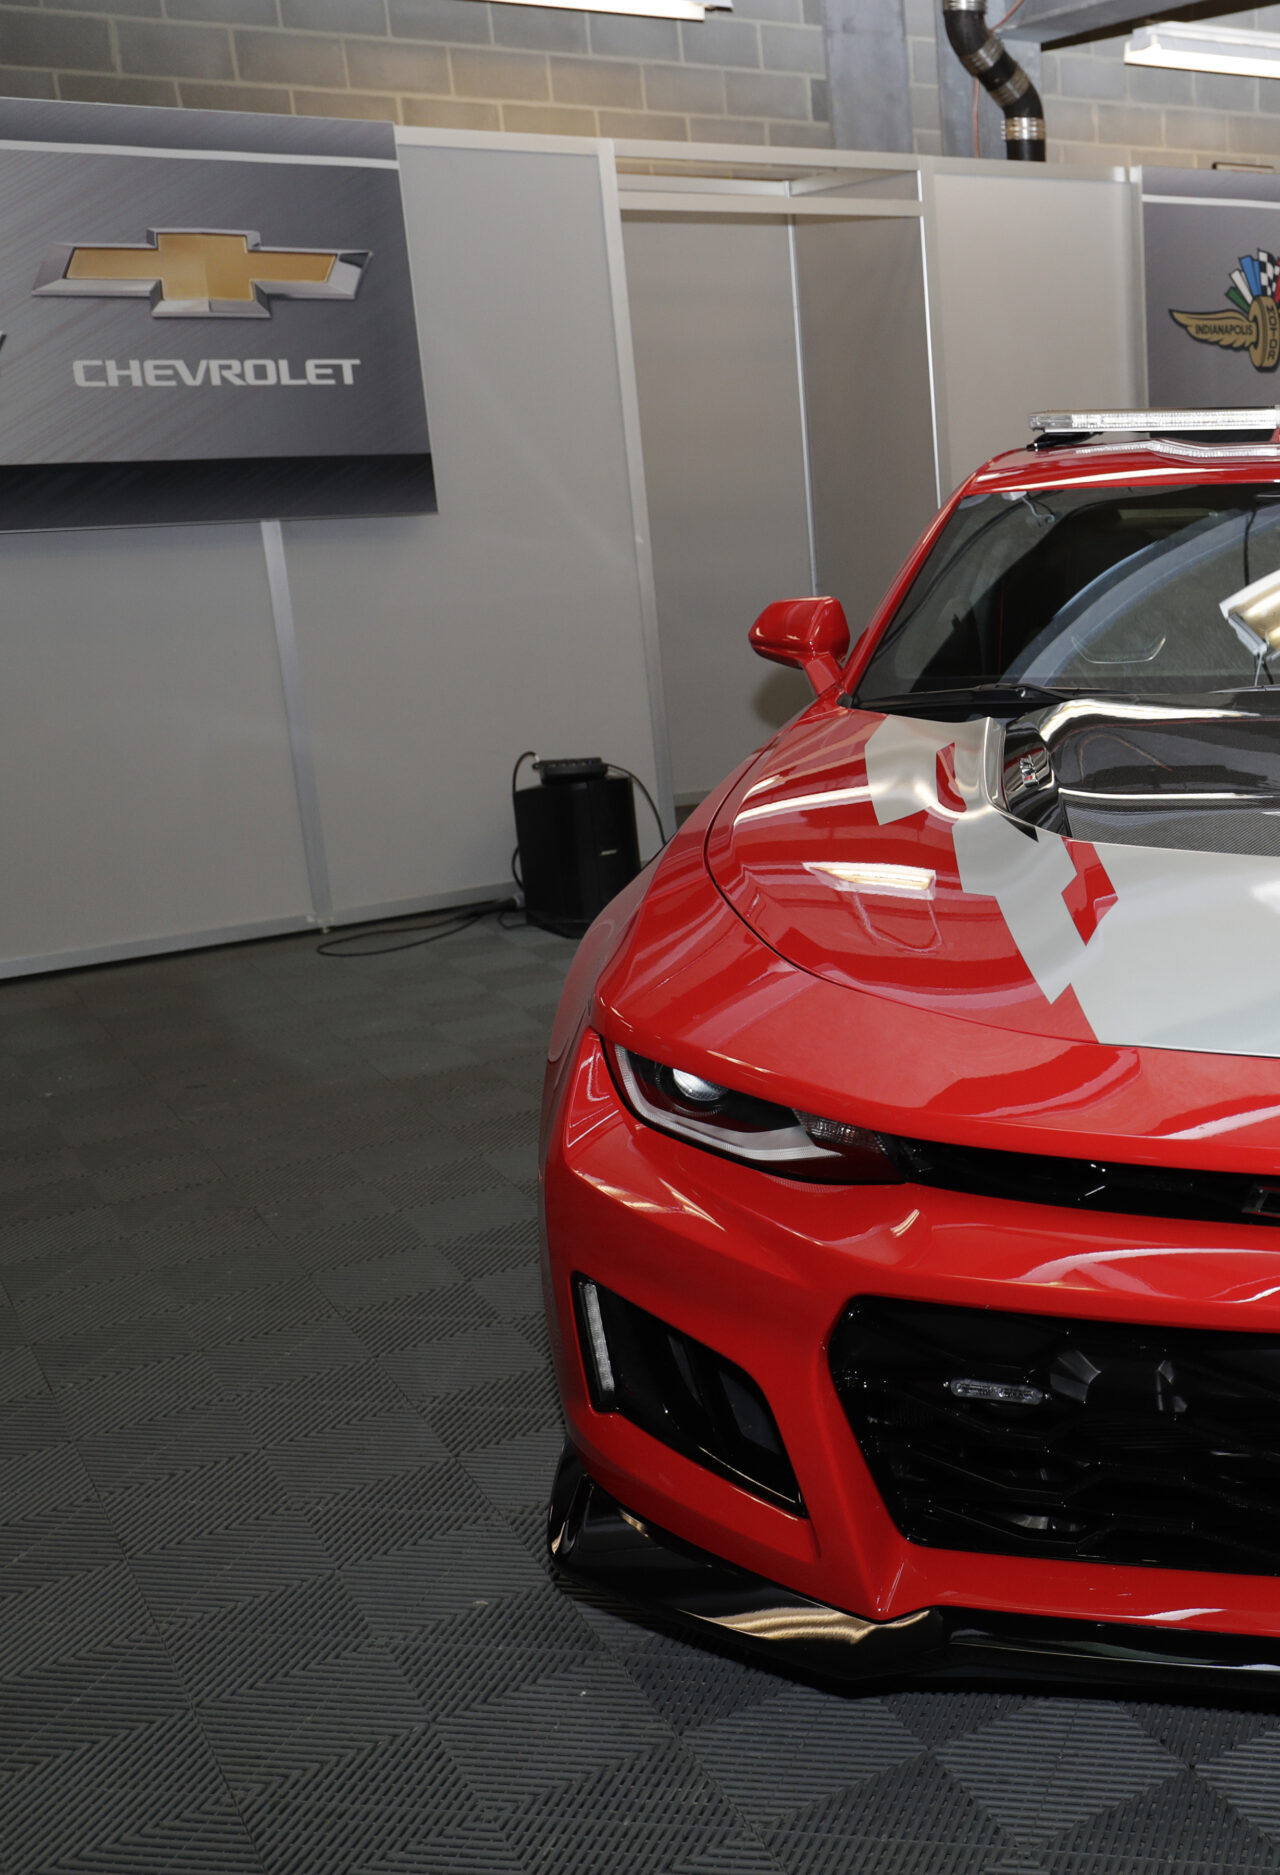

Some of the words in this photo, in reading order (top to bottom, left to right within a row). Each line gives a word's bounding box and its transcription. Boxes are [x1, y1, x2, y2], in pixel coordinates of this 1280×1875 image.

[1195, 323, 1254, 336] INDIANAPOLIS
[1266, 306, 1277, 361] MOTOR
[72, 358, 361, 388] CHEVROLET
